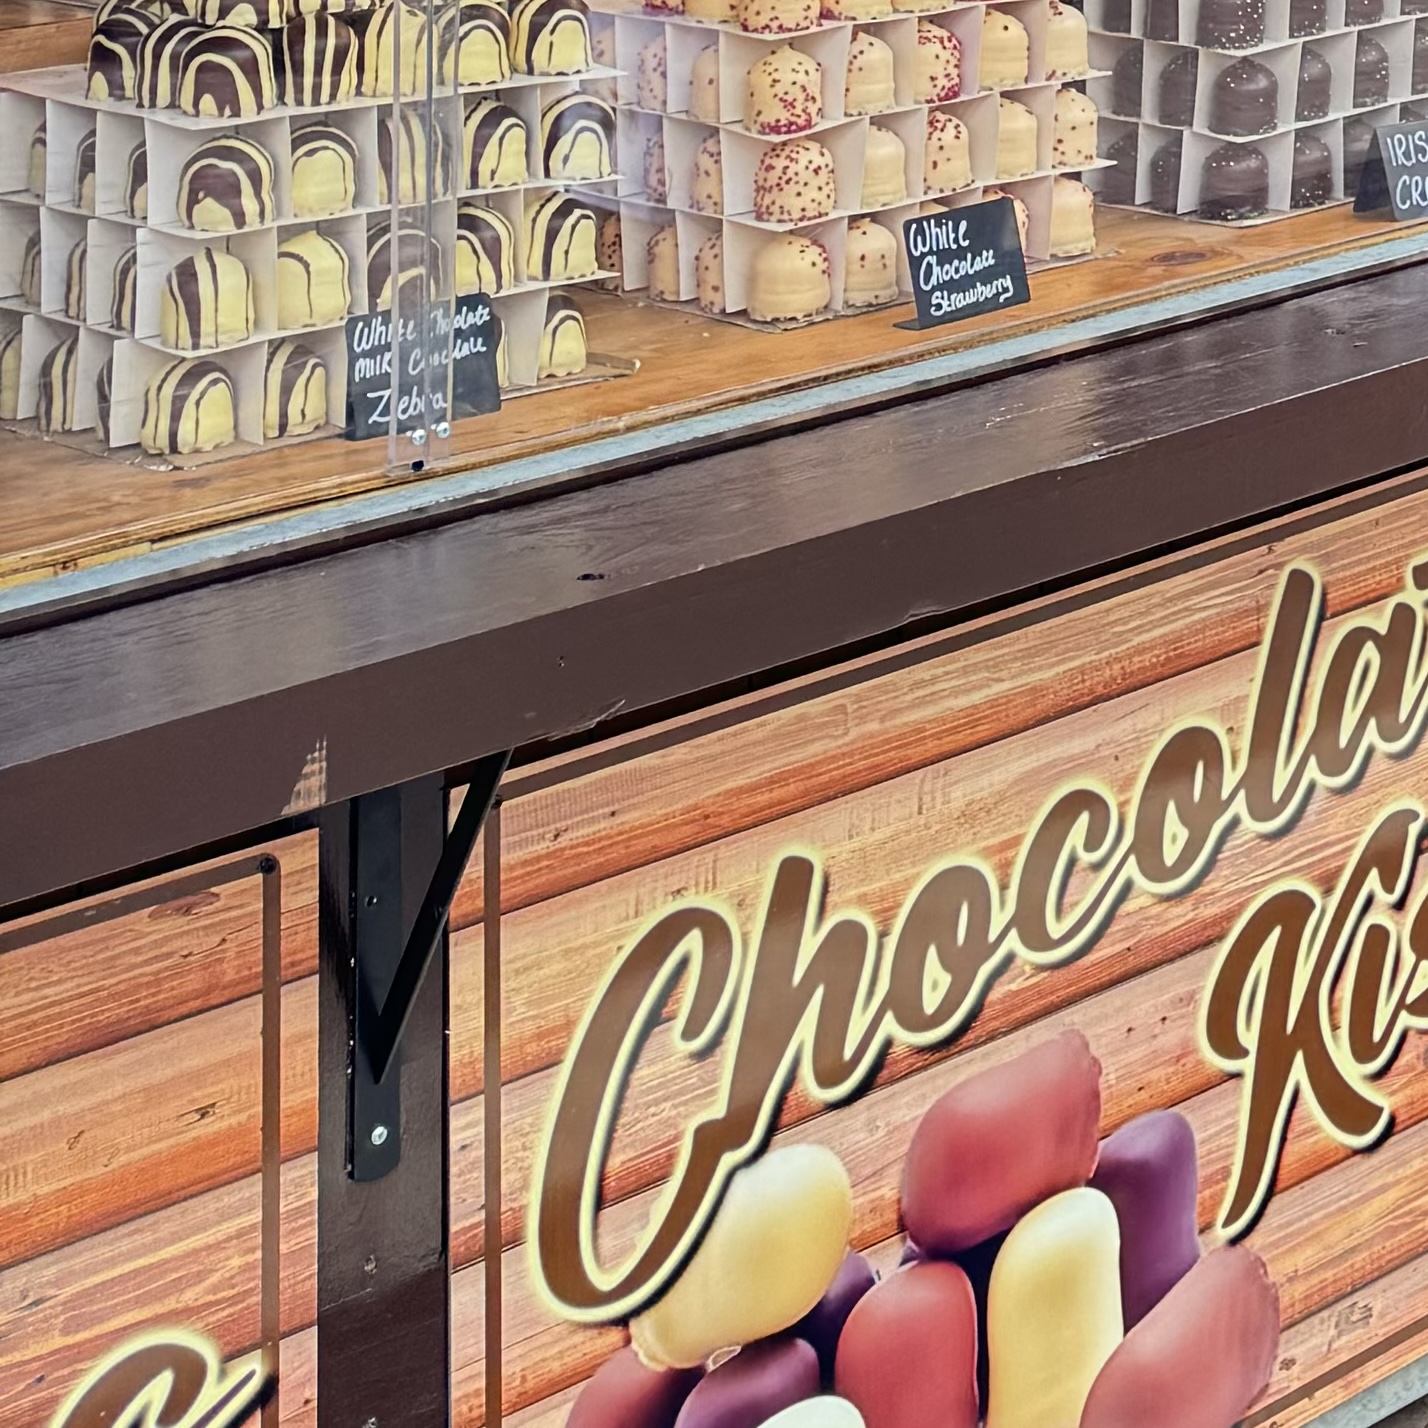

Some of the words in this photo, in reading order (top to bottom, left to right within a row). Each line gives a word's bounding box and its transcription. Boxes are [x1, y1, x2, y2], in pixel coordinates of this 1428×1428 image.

[910, 219, 970, 256] White
[919, 249, 996, 291] Chocolate
[930, 274, 1014, 316] Strawberry
